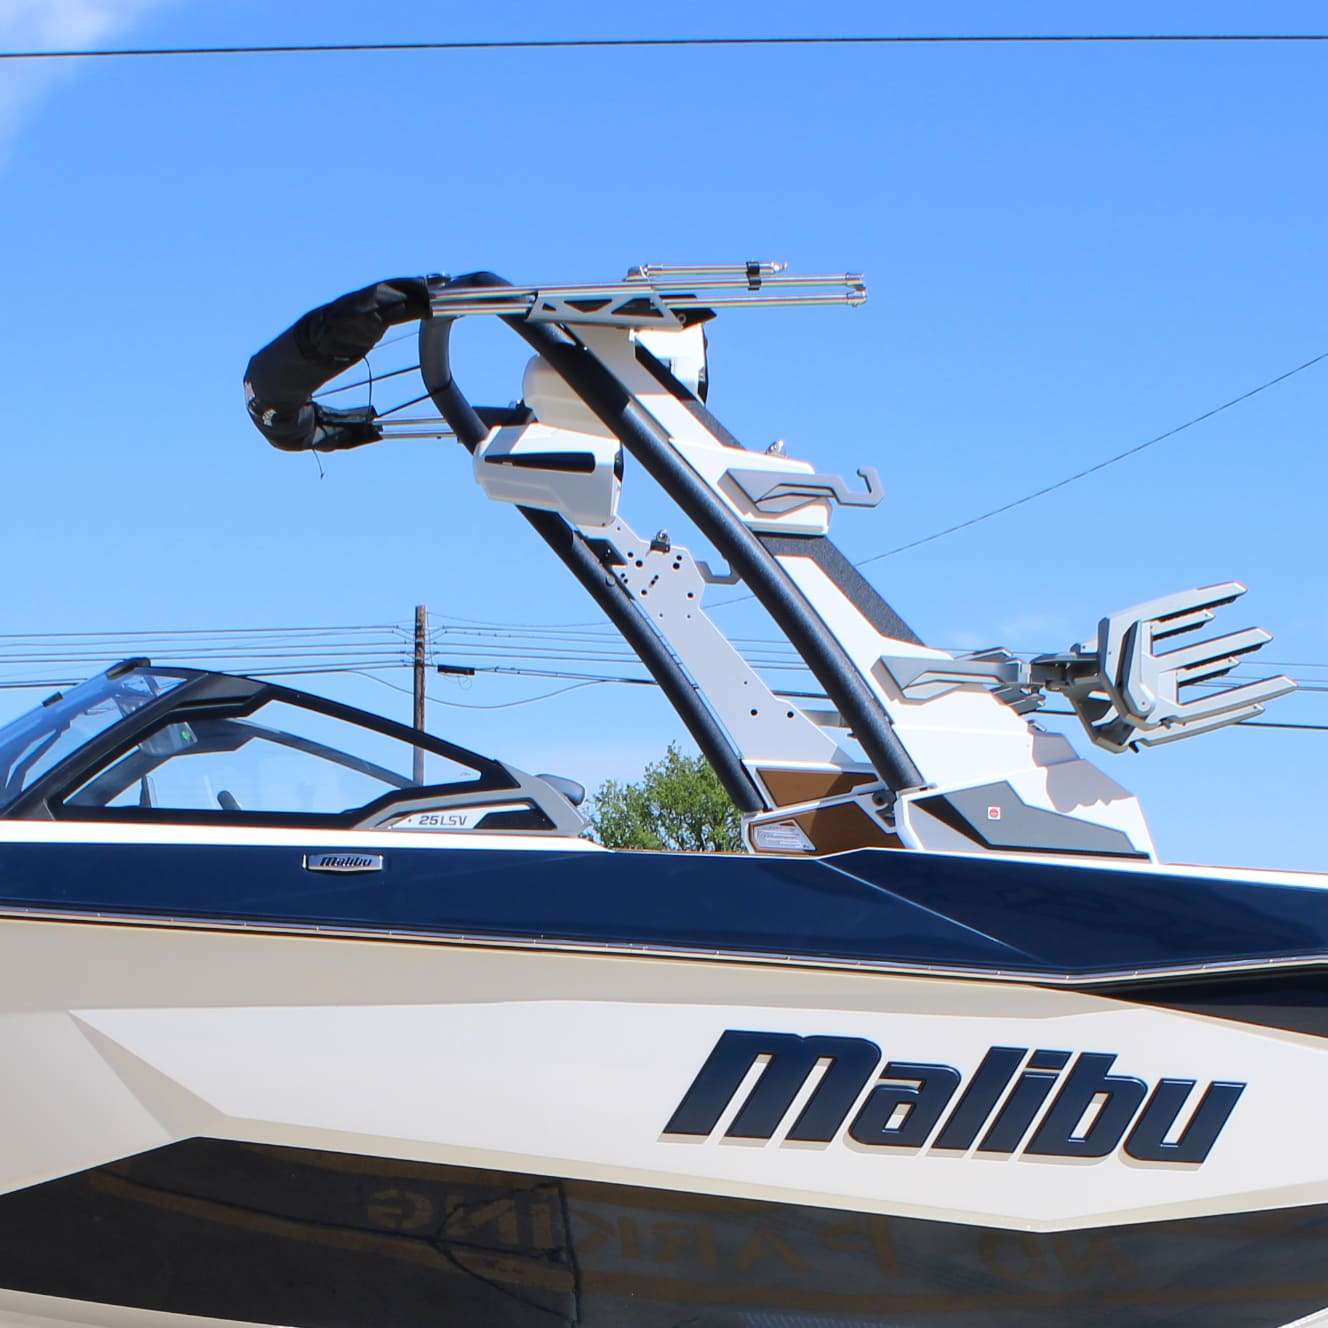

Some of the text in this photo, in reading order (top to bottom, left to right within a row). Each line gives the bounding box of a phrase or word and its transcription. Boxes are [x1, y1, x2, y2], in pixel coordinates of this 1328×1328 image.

[418, 815, 468, 826] 25LSV
[319, 856, 373, 867] Malibu
[660, 1029, 1248, 1166] Malibu
